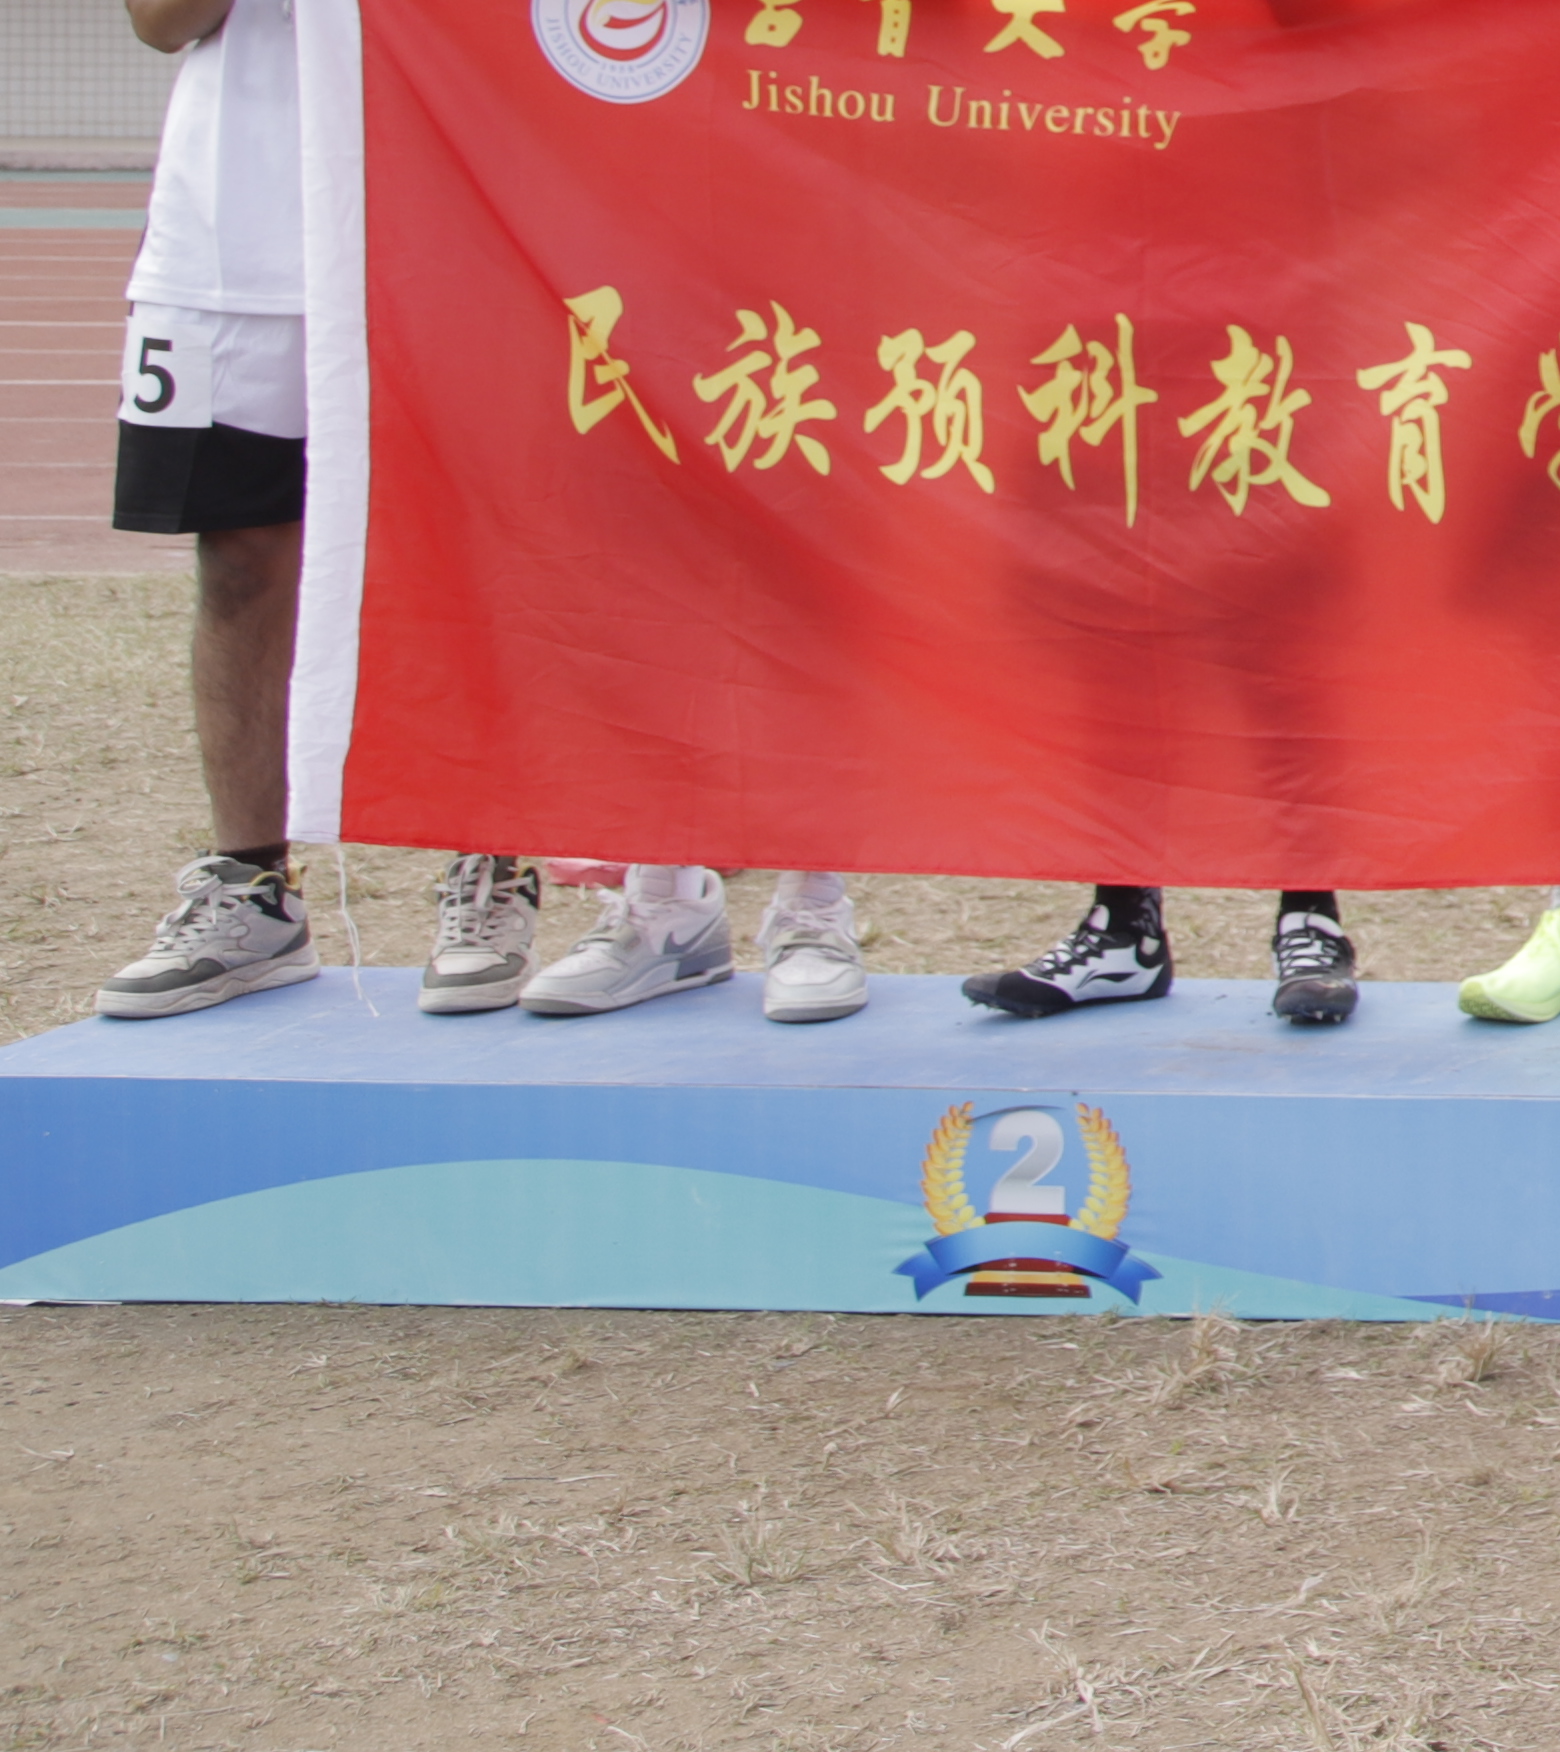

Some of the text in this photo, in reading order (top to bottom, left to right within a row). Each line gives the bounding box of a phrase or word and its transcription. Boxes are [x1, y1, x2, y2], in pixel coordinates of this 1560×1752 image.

[742, 70, 1181, 150] Jishou University
[134, 336, 176, 414] 5
[989, 1111, 1066, 1214] 2
